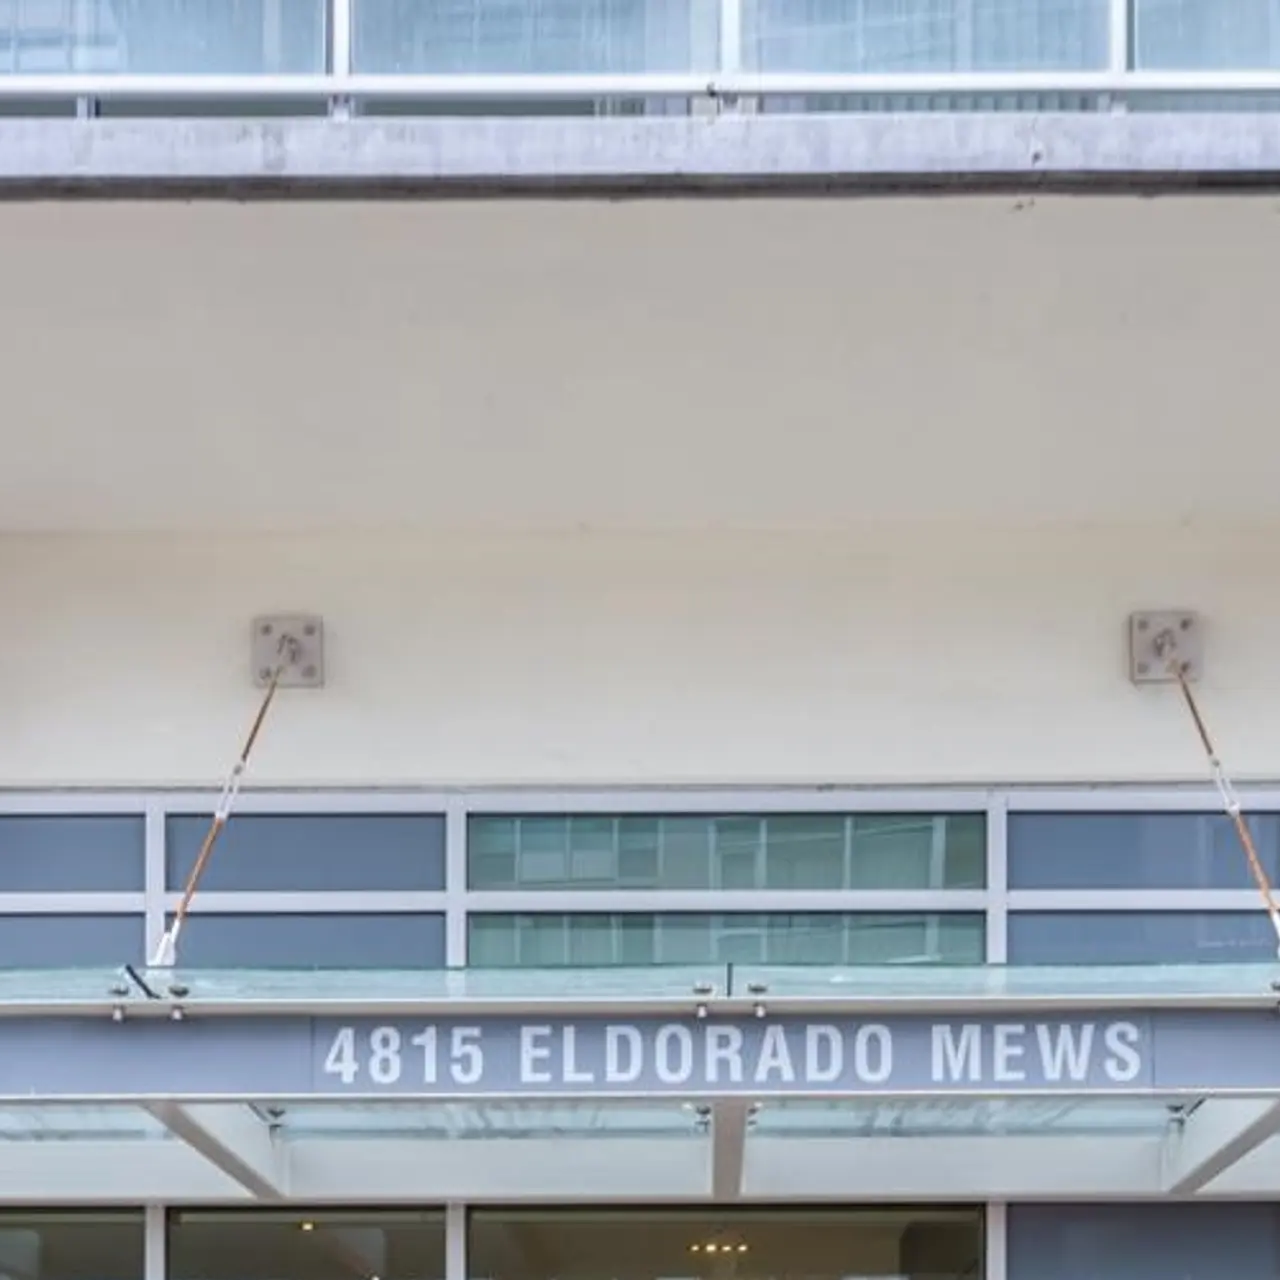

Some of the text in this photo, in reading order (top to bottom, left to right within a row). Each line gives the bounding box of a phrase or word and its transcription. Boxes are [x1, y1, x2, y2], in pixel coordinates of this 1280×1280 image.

[325, 1022, 1143, 1085] 4815 ELDORADO MEWS
